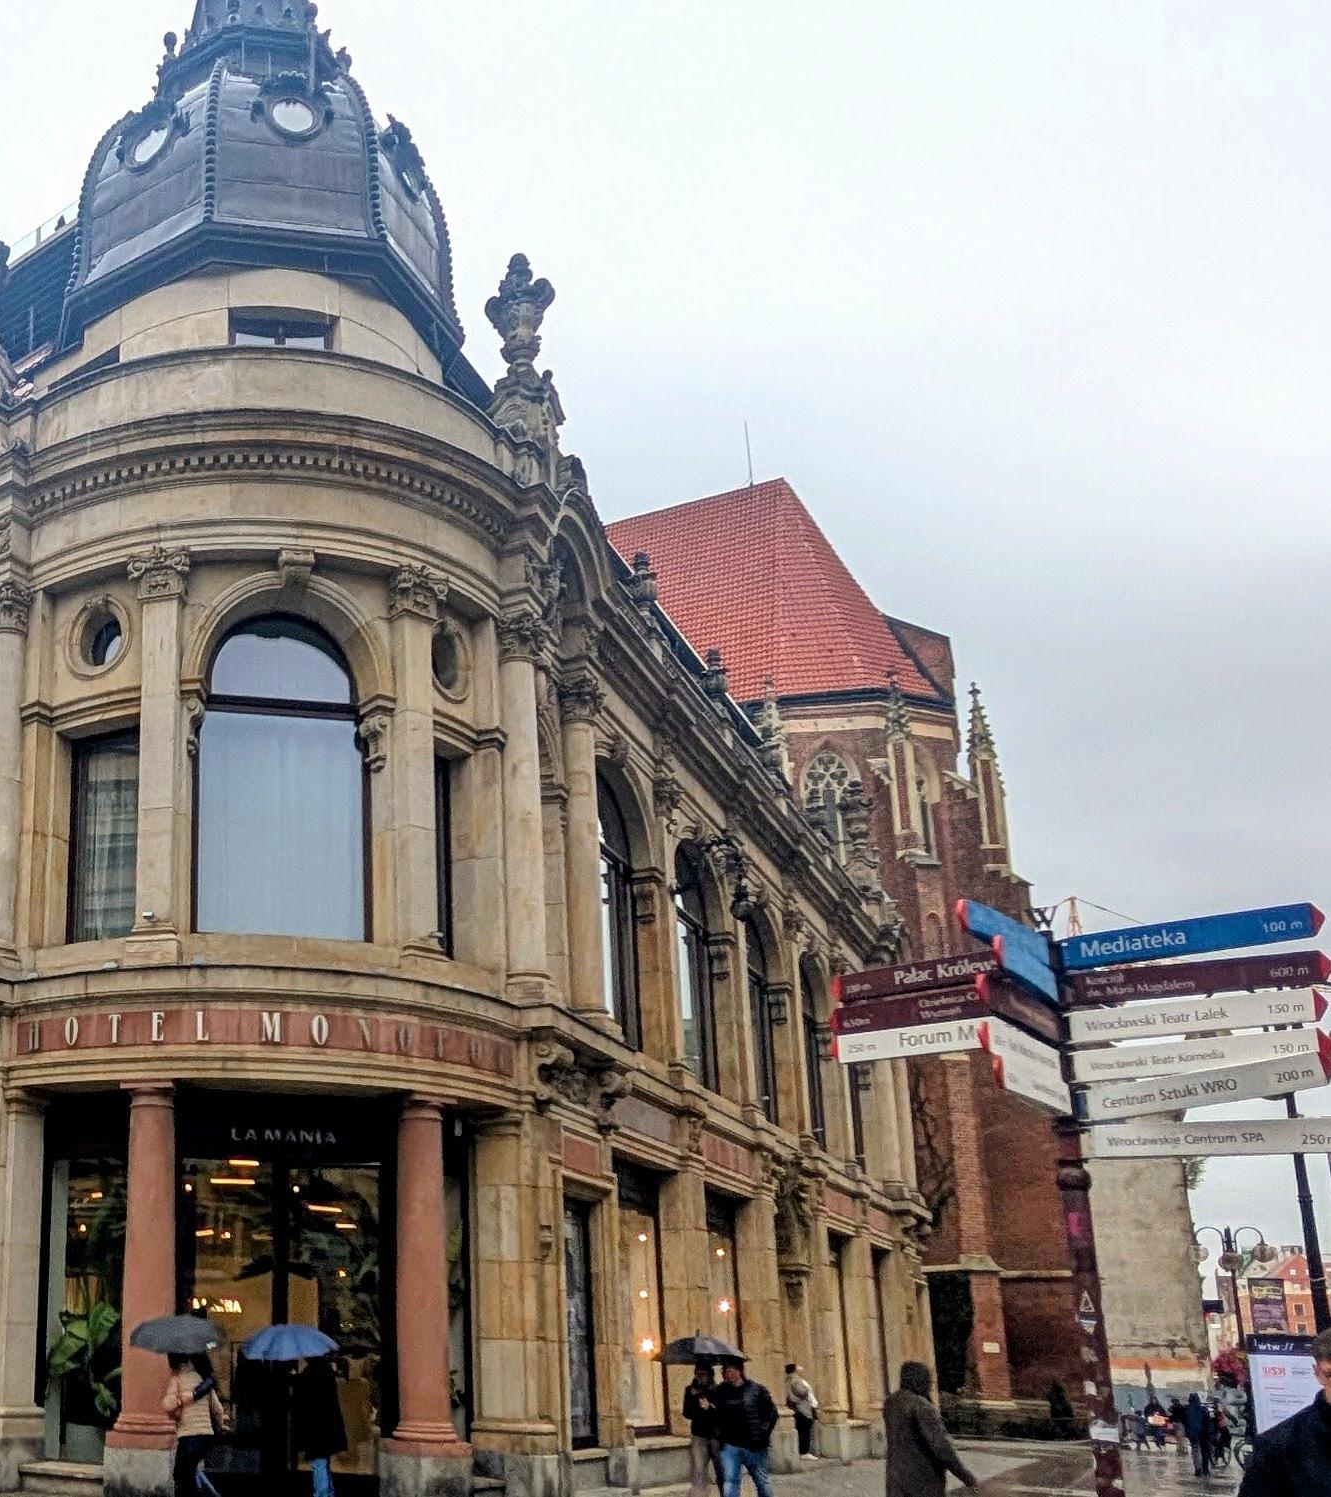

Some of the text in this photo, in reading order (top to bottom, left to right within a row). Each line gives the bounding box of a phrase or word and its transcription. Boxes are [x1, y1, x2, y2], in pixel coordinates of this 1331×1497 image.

[1080, 919, 1304, 957] Mediateka 100 m
[1296, 965, 1310, 976] m
[1159, 1011, 1191, 1025] Teatr
[1195, 1006, 1229, 1022] Lalek
[1267, 1003, 1289, 1014] 150
[1293, 1003, 1305, 1013] m
[28, 1010, 210, 1051] HOTEL
[899, 1030, 953, 1048] Forum
[1178, 1048, 1226, 1063] Komedia
[1272, 1043, 1294, 1055] 150
[1101, 1068, 1315, 1110] Centrum Sztuki WRO 200 m
[230, 1127, 337, 1145] LA MANIA
[1184, 1131, 1238, 1145] Centrum
[1242, 1130, 1266, 1144] SPA
[1301, 1133, 1326, 1146] 250
